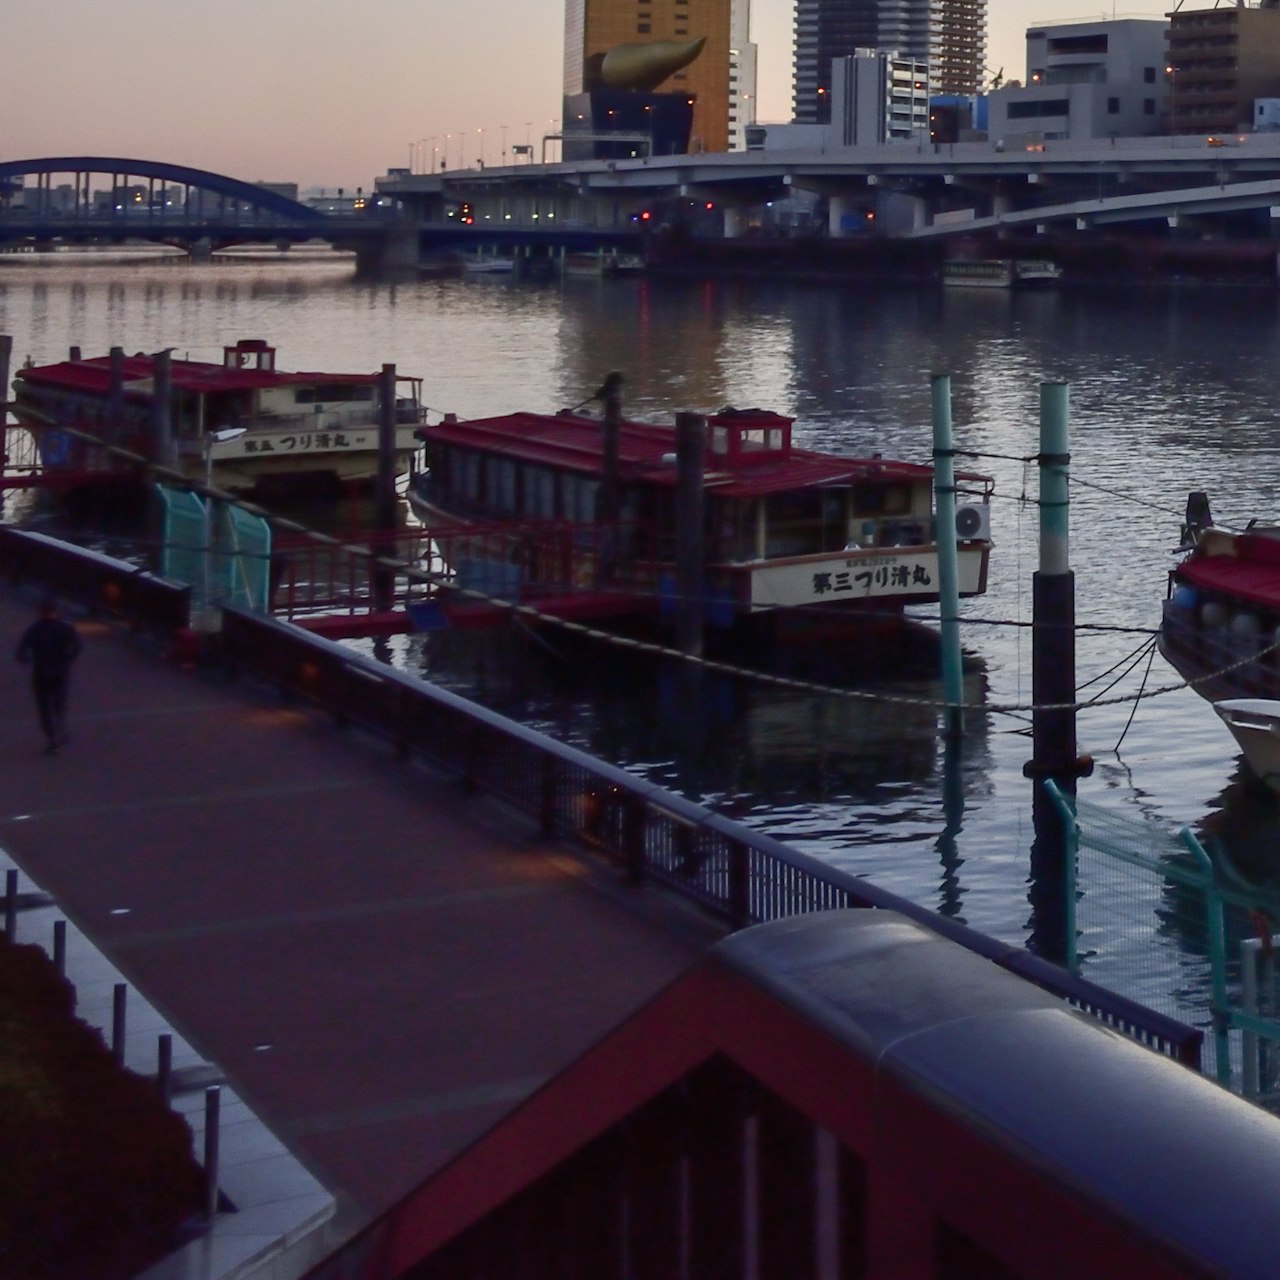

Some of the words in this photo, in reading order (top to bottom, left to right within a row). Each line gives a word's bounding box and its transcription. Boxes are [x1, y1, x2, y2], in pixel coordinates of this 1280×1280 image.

[812, 563, 931, 594] 第三つり清丸
